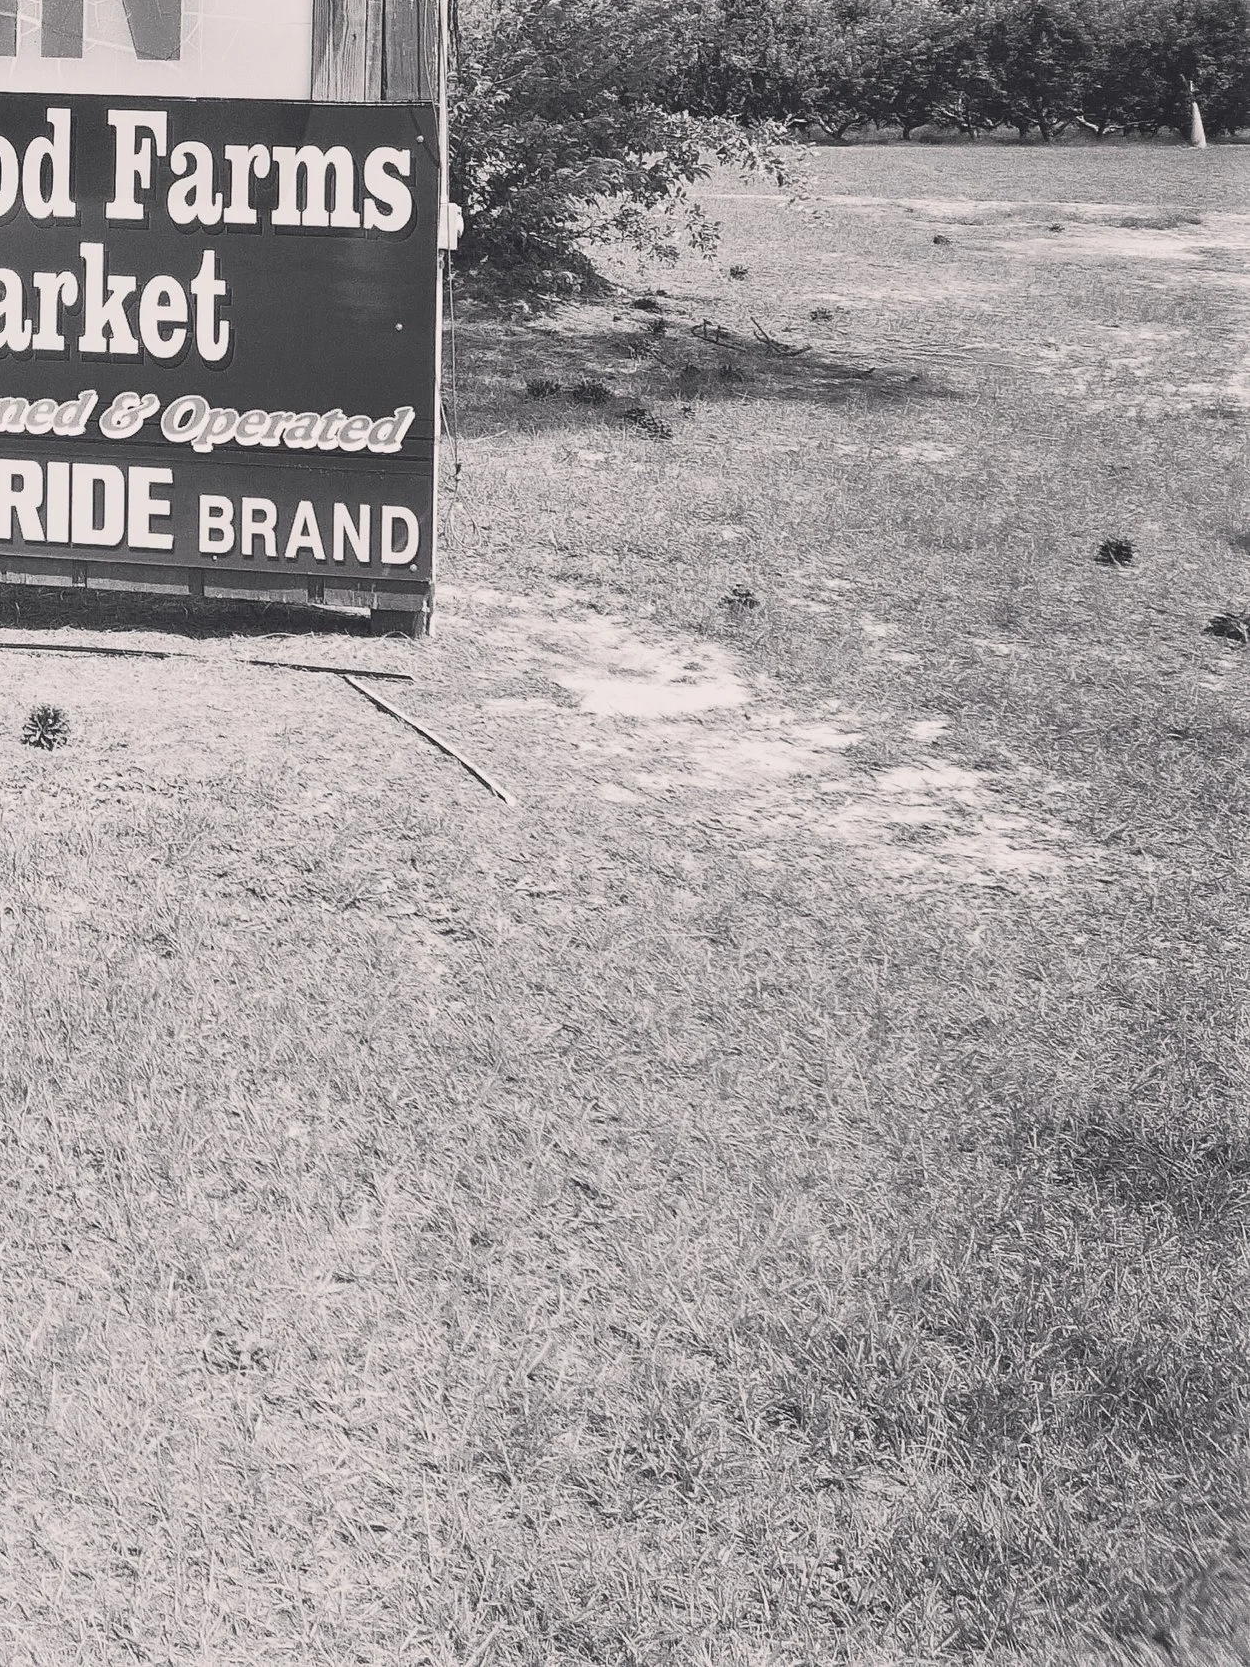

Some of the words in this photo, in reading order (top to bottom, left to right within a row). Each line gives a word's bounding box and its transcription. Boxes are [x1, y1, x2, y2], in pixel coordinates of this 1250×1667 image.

[105, 109, 414, 232] Farms
[99, 392, 159, 439] &
[162, 396, 415, 452] Operated
[197, 494, 420, 565] BRAND
